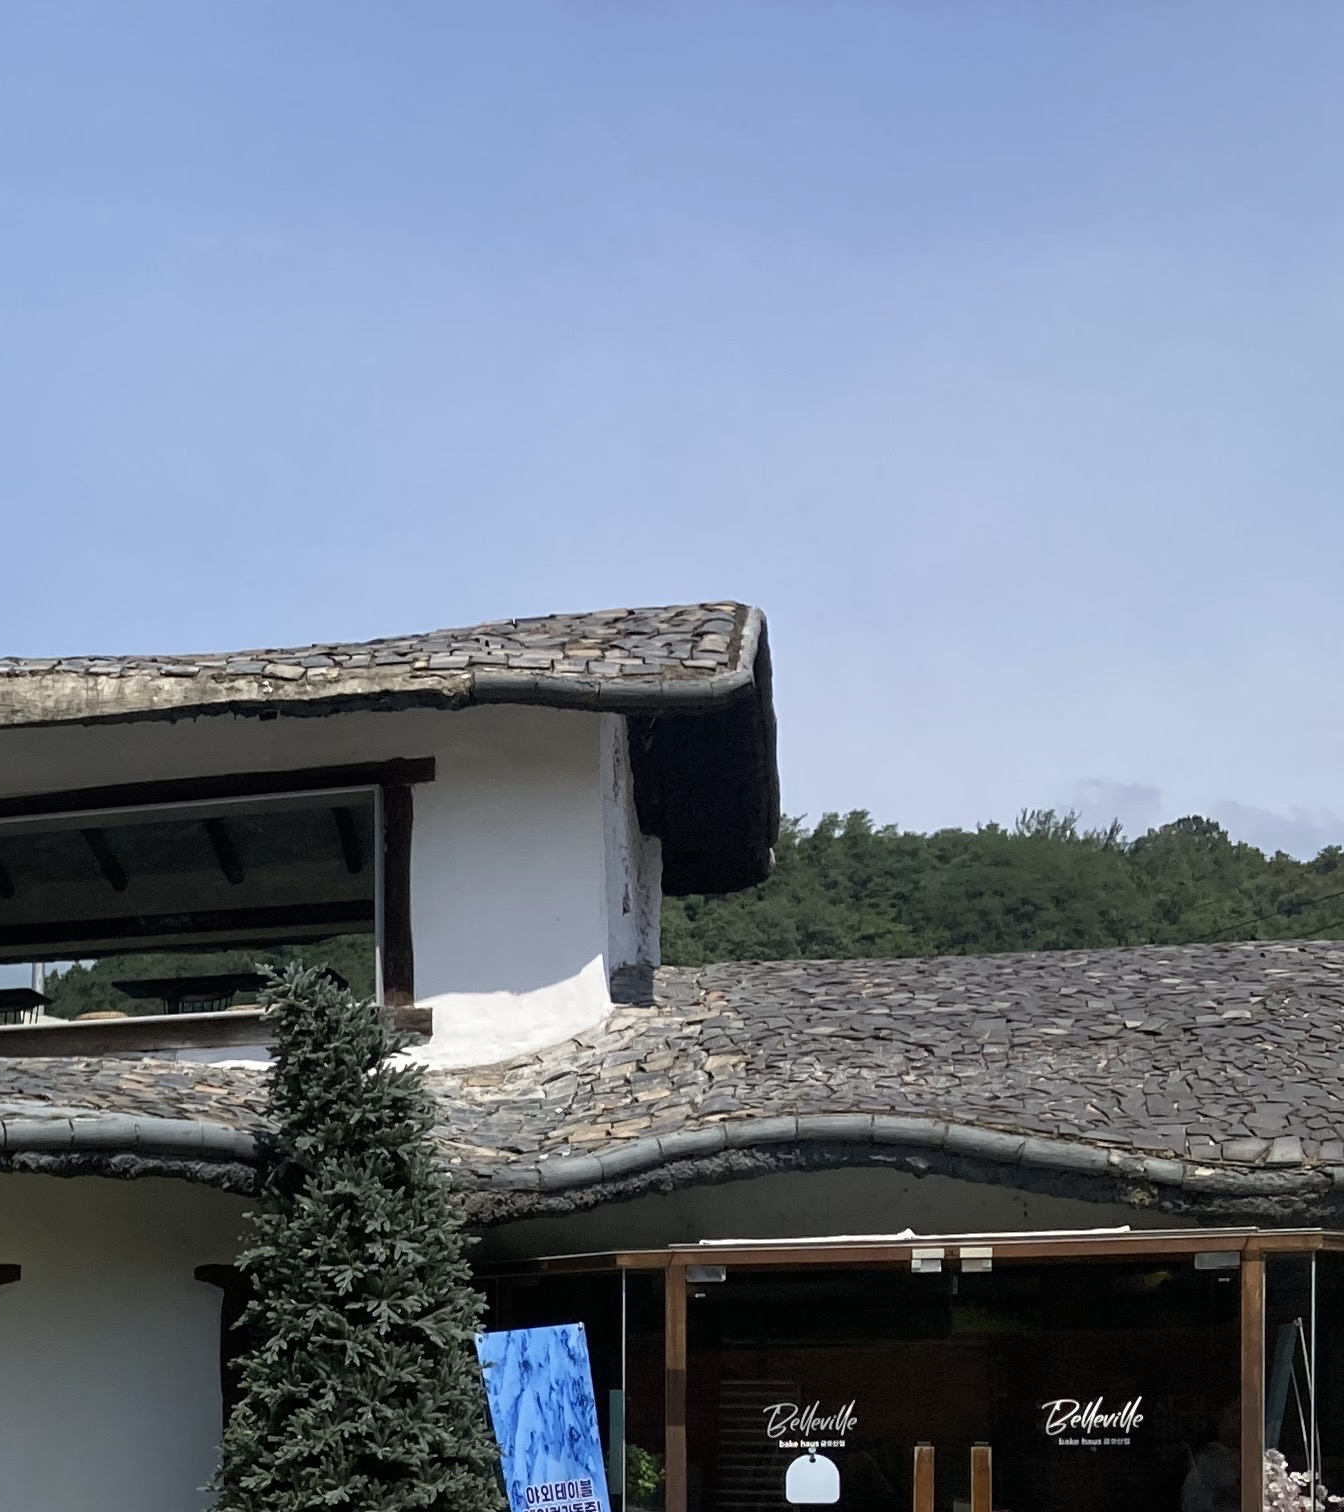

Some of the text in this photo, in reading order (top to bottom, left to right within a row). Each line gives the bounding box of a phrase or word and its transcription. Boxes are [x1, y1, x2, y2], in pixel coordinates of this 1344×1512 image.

[762, 1399, 858, 1438] Belleville
[1041, 1396, 1144, 1436] Belleville
[778, 1439, 799, 1448] bake
